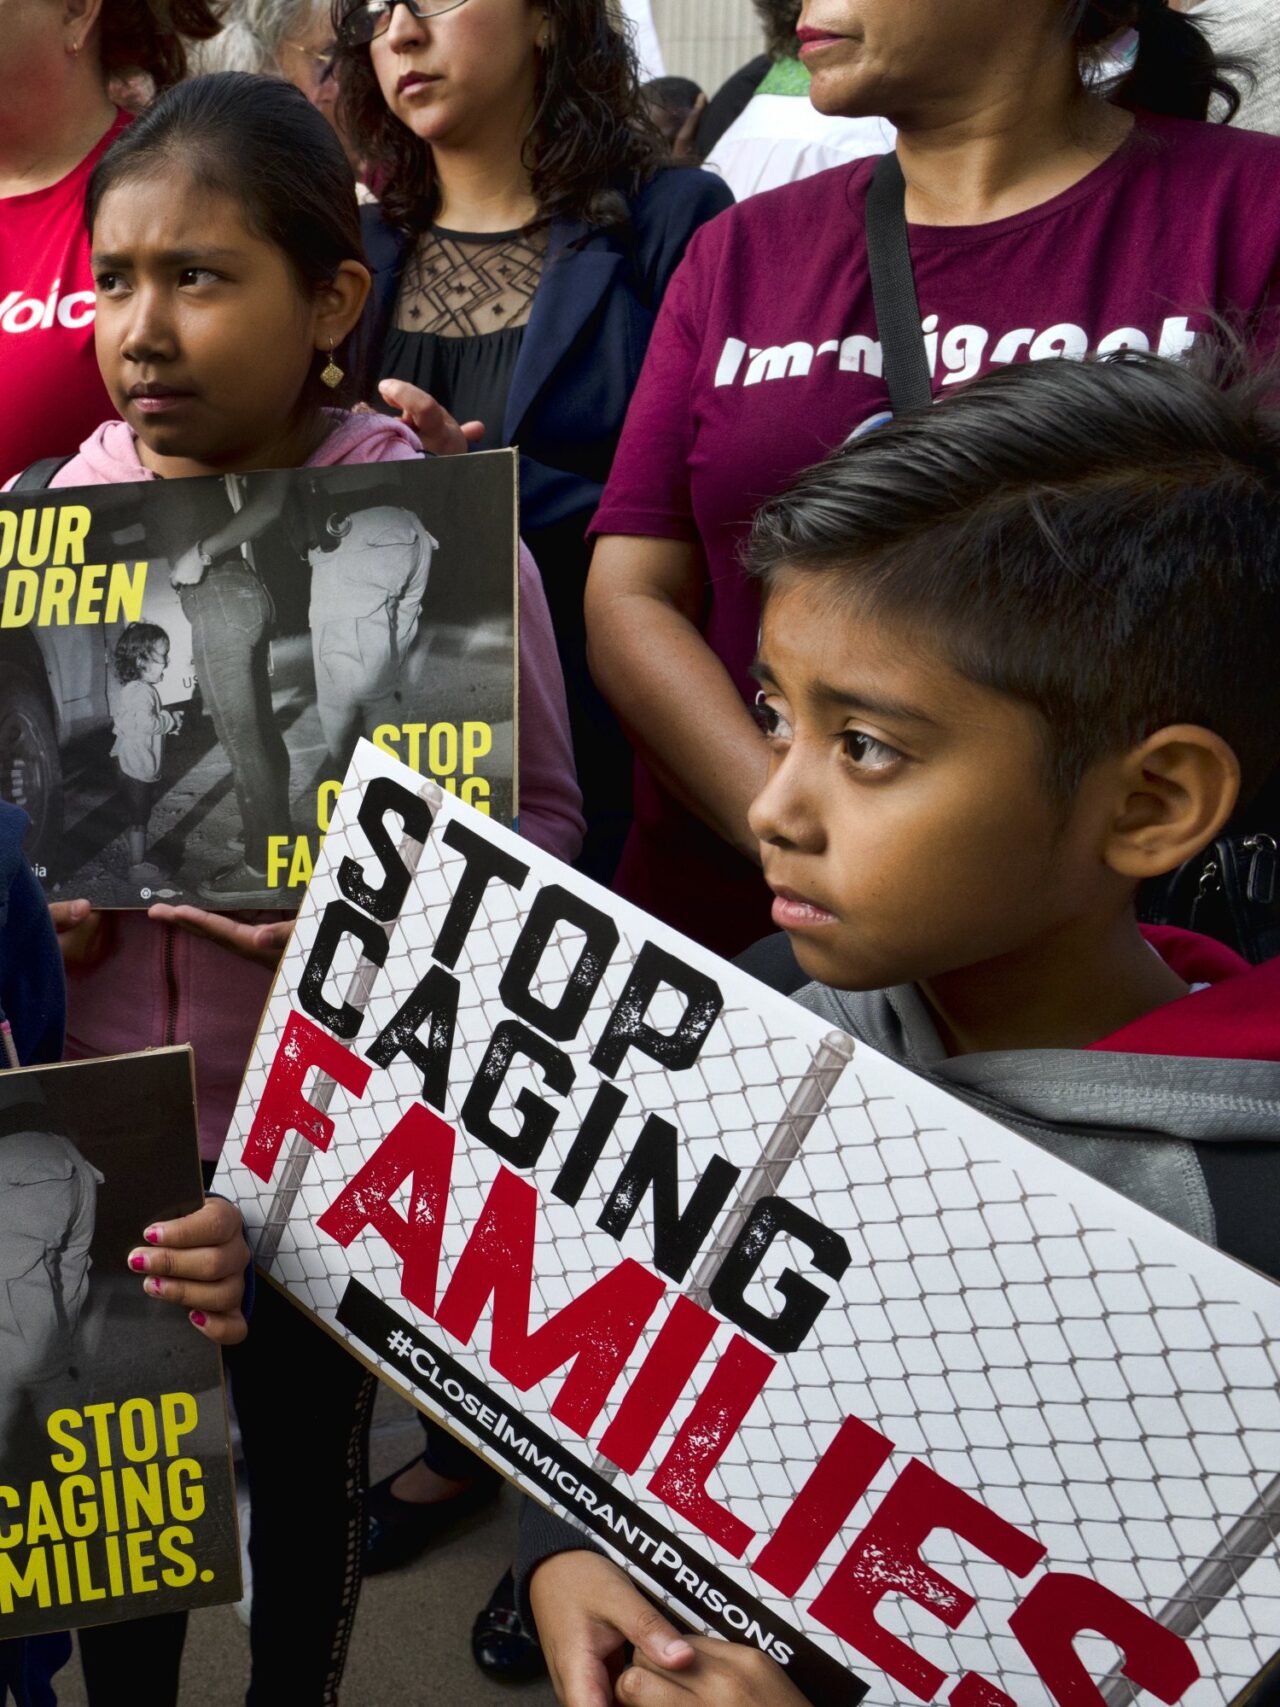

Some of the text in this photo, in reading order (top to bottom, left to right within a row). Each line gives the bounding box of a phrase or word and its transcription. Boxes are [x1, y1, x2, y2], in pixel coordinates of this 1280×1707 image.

[372, 721, 492, 776] STOP
[337, 778, 723, 1080] STOP
[297, 900, 852, 1354] CAGING
[47, 1392, 199, 1474] STOP
[240, 1010, 1201, 1707] FAMILIES
